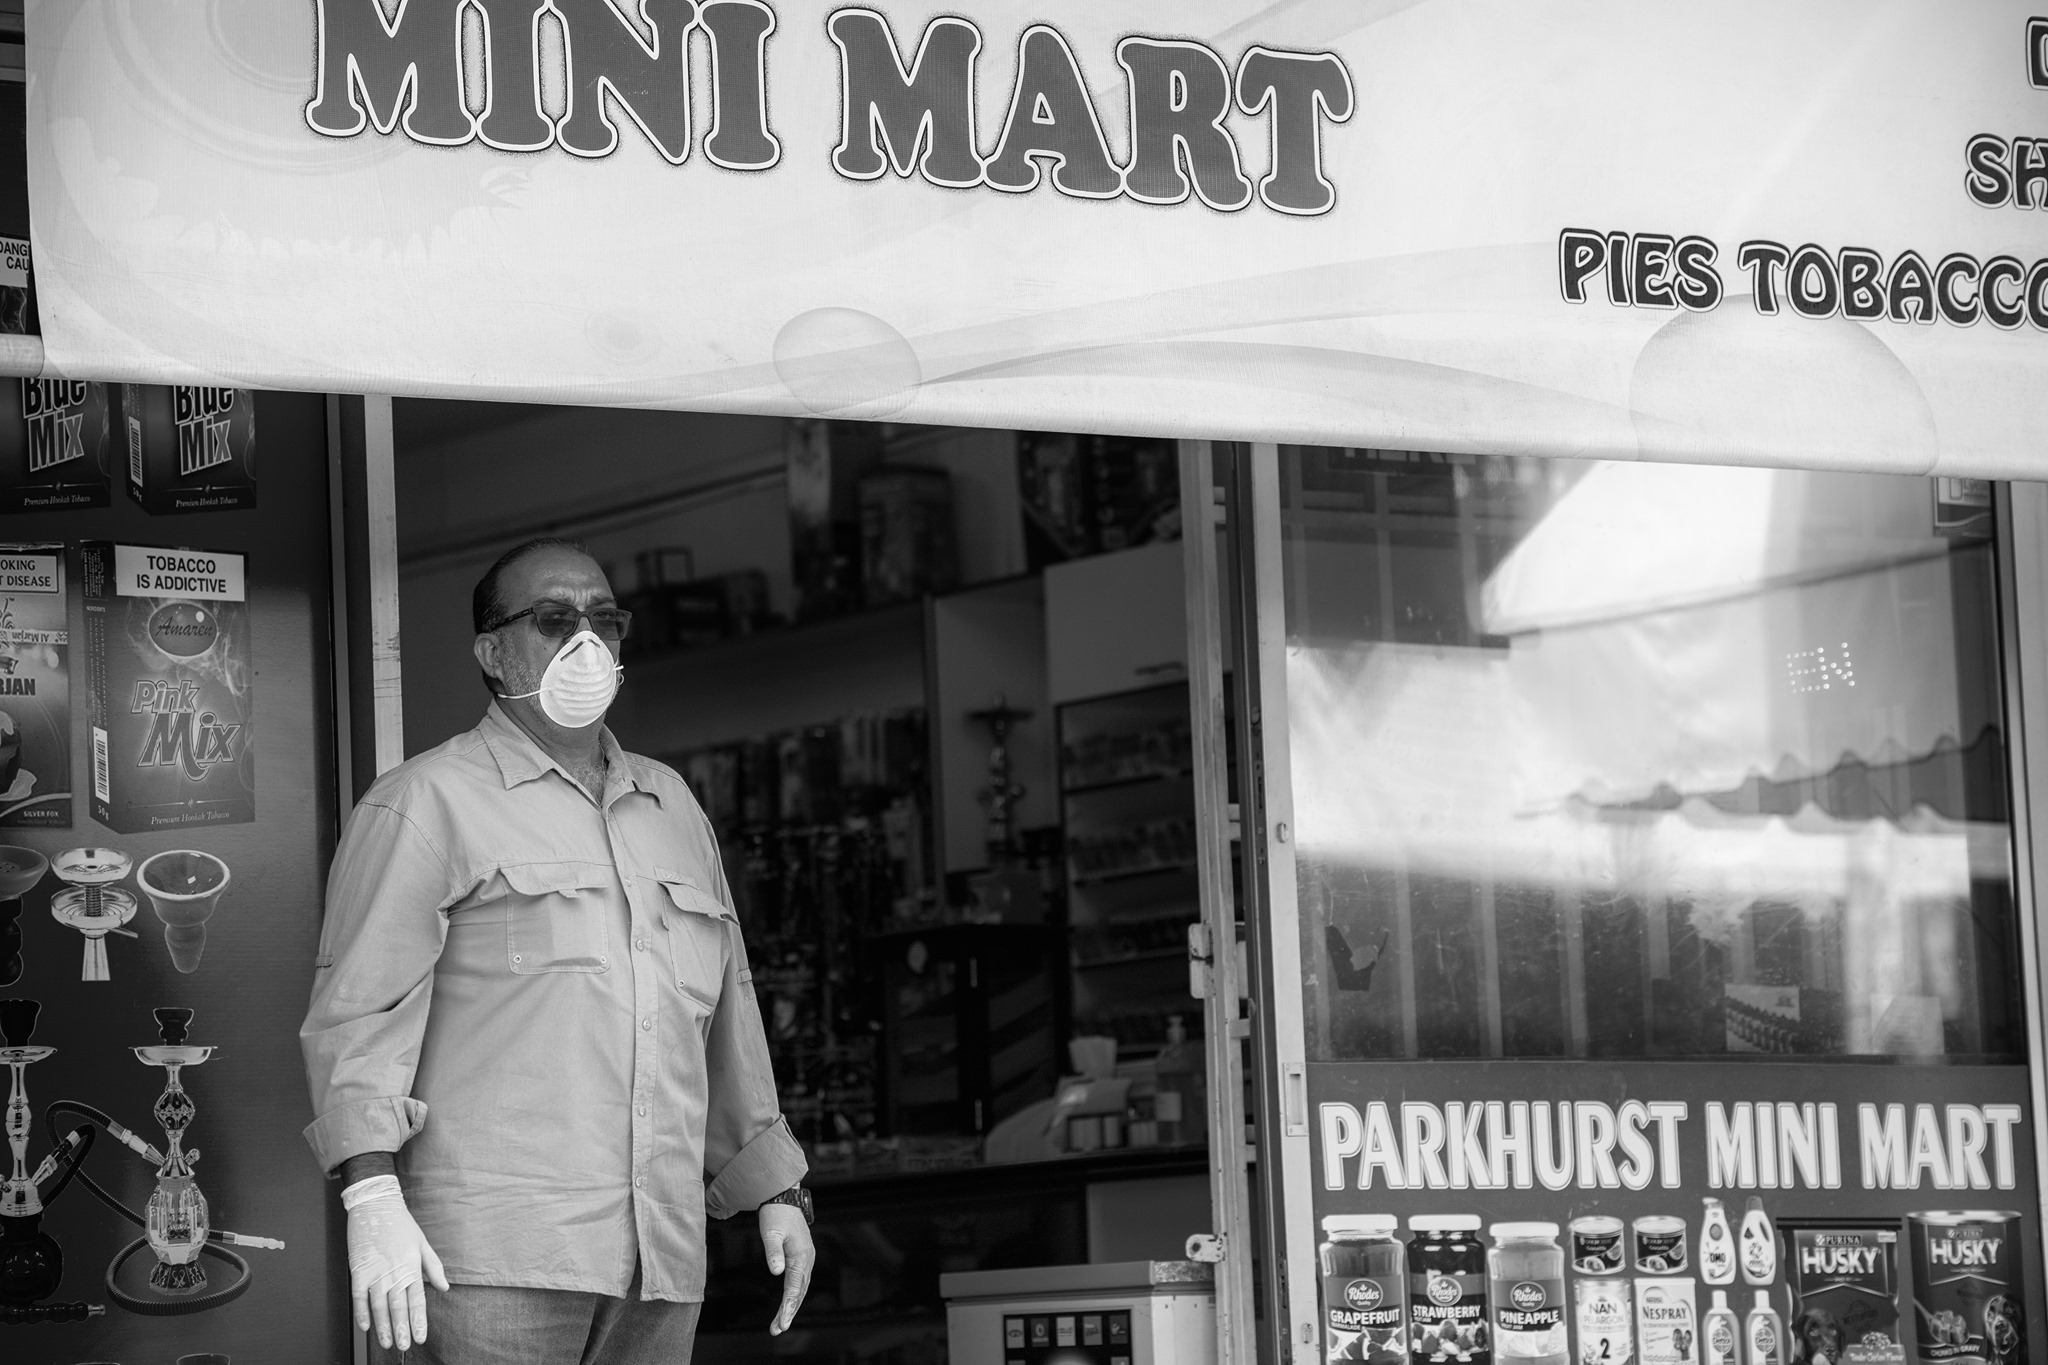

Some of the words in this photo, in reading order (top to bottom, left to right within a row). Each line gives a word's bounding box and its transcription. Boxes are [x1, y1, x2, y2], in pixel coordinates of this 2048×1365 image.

[305, 0, 782, 171] MINI
[829, 8, 1355, 216] MART
[1559, 228, 1723, 313] PIES
[22, 377, 86, 419] Blue
[173, 384, 234, 425] Blue
[28, 408, 85, 472] Mix
[179, 415, 232, 476] Mix
[146, 555, 216, 574] TOBACCO
[6, 575, 51, 587] DISEASE
[136, 573, 150, 589] IS
[153, 575, 227, 593] ADDICTIVE
[131, 680, 200, 714] Pink
[136, 711, 243, 782] Mix
[151, 816, 180, 825] Premium
[181, 812, 205, 822] Hookah
[206, 810, 230, 821] Tobacco
[1319, 1099, 1688, 1191] PARKHURST
[1704, 1101, 1841, 1189] MINI
[1857, 1103, 2021, 1190] MART
[1802, 1246, 1878, 1274] HUSKY
[1930, 1238, 2000, 1265] HUSKY
[1348, 1286, 1380, 1300] Rhodes
[1513, 1288, 1543, 1302] Rhodes
[1330, 1308, 1400, 1325] GRAPEFRUIT
[1412, 1304, 1481, 1318] STRAWBERRY
[1500, 1310, 1559, 1325] PINEAPPLE
[1589, 1303, 1617, 1314] NAN
[1643, 1306, 1687, 1320] NESPRAY
[1600, 1338, 1611, 1359] 2
